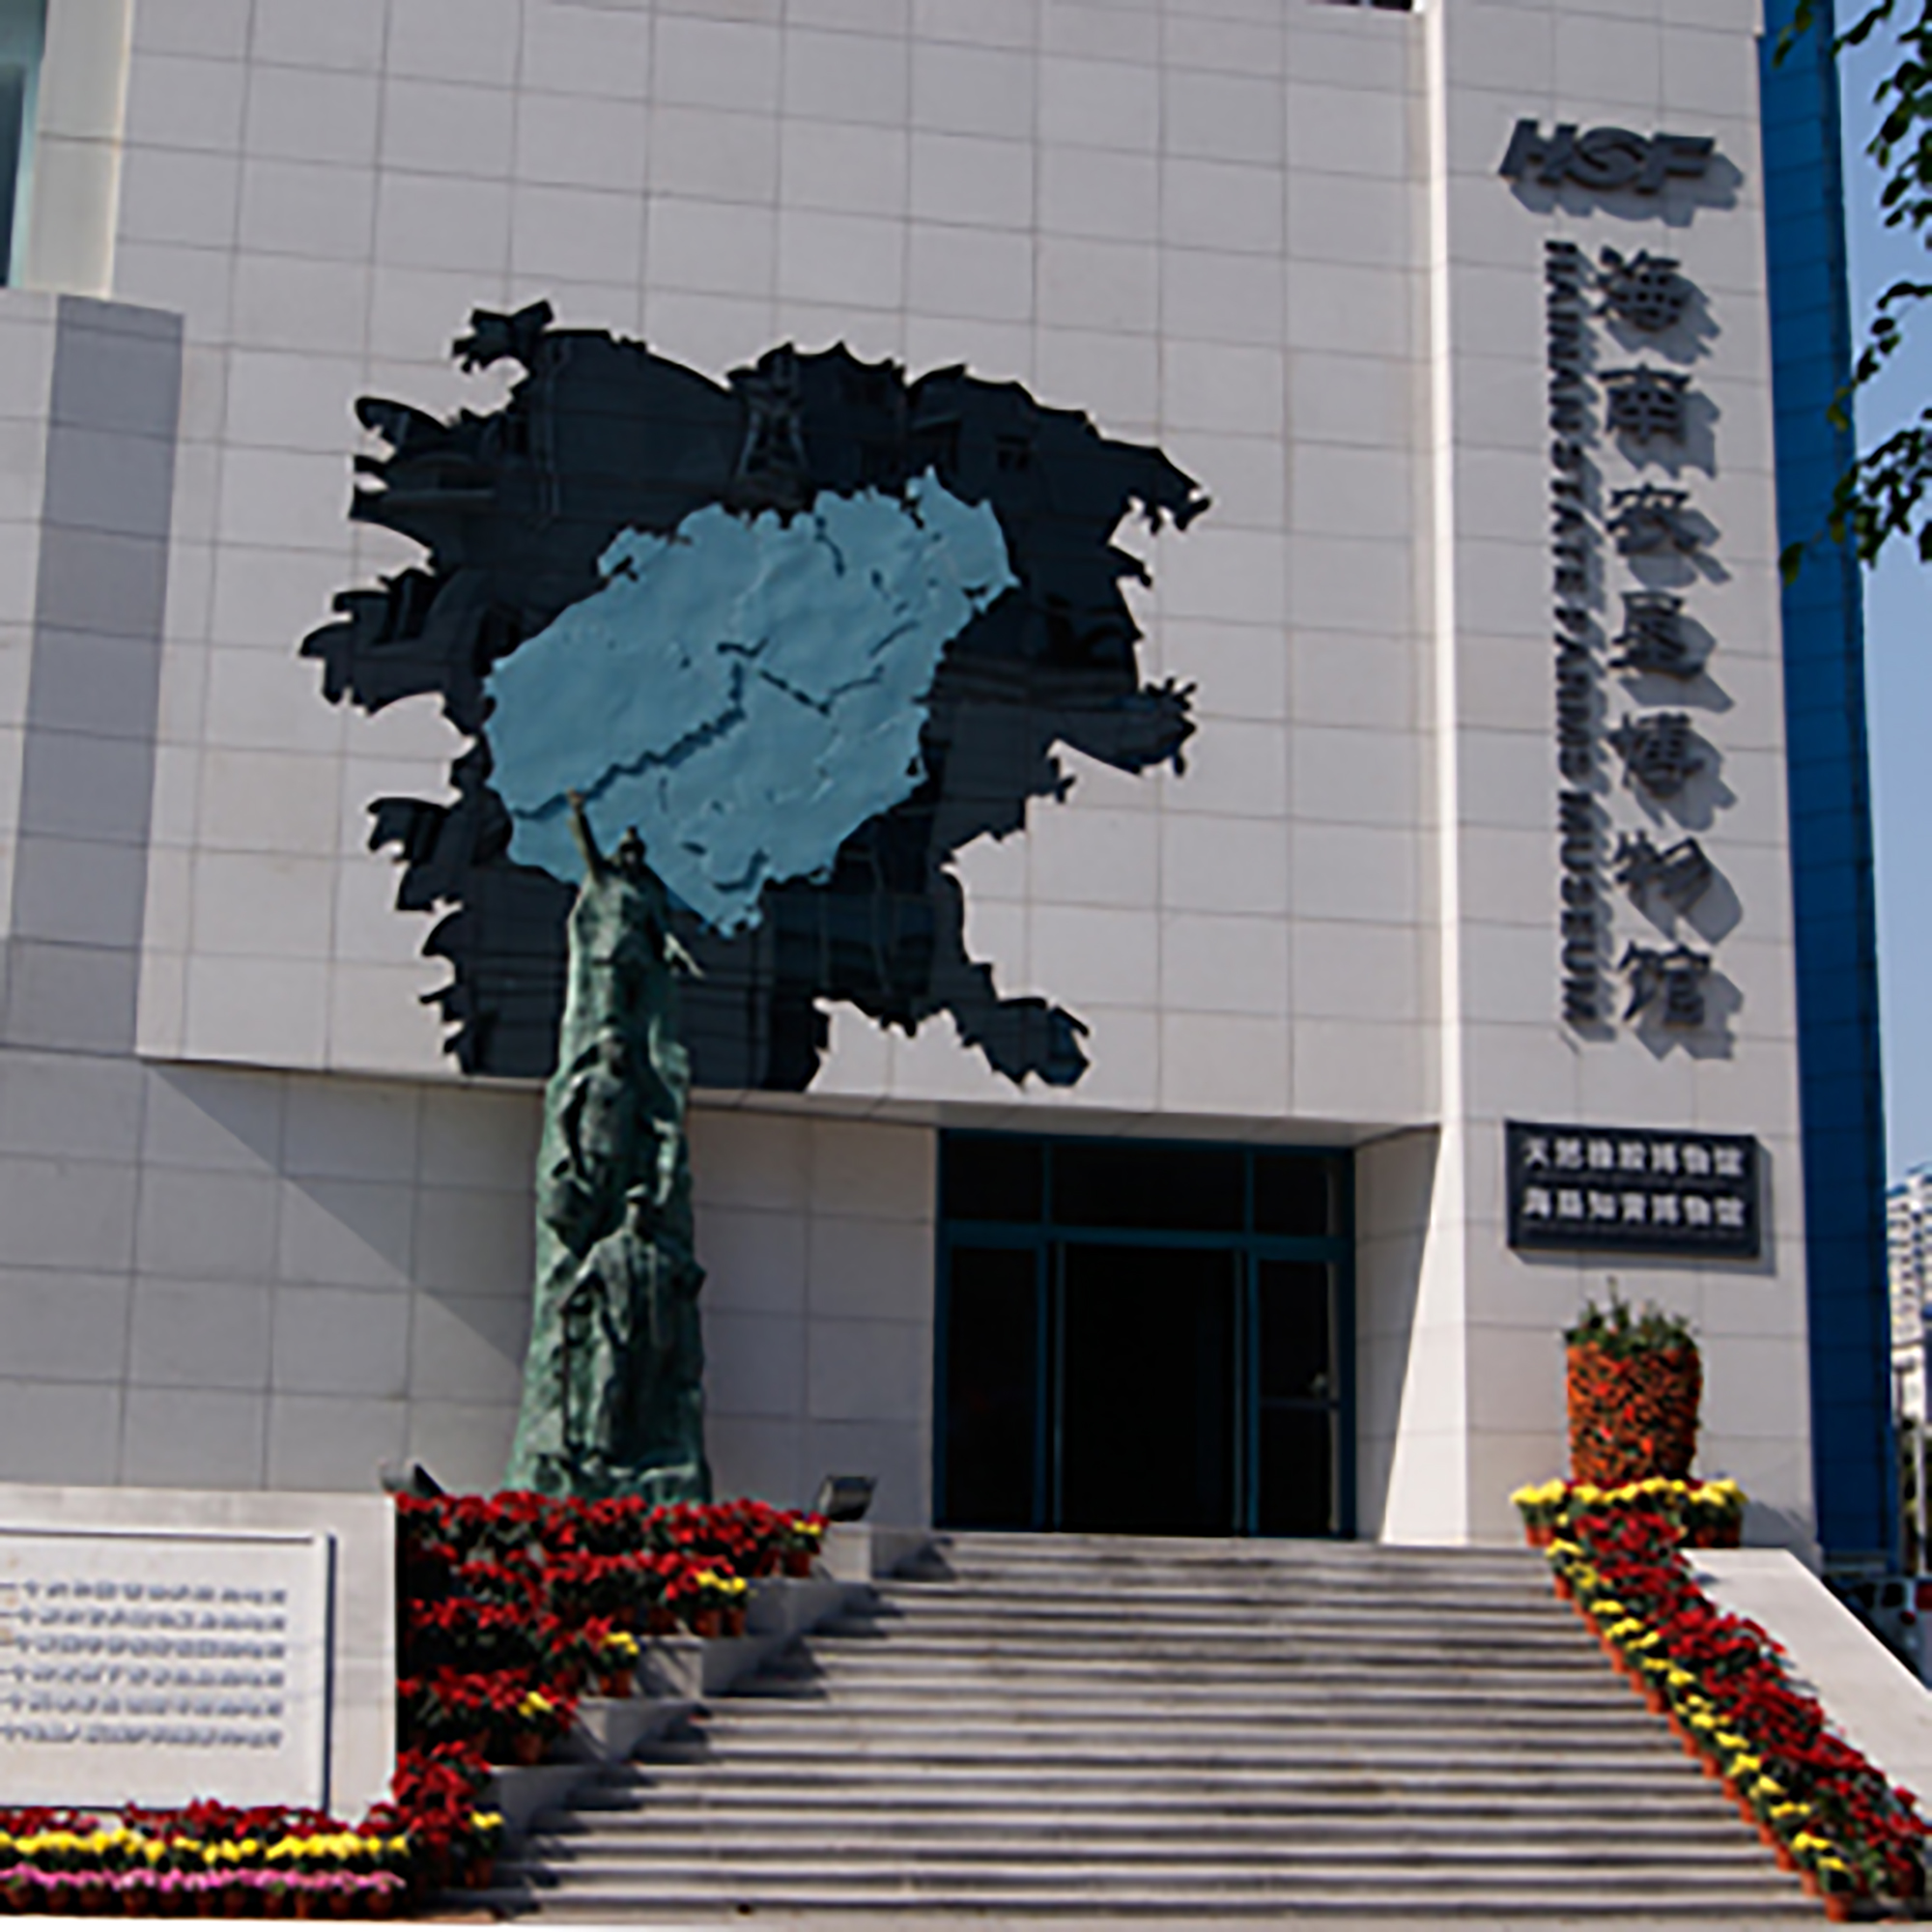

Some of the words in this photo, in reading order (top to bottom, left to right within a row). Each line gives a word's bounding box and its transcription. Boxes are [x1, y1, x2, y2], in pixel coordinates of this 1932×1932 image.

[1546, 240, 1581, 431] HAINAN
[1551, 441, 1586, 593] STATE
[1554, 606, 1592, 781] FARMS
[1594, 244, 1711, 1025] 海南农垦博物馆
[1558, 790, 1596, 1025] MUSEUM
